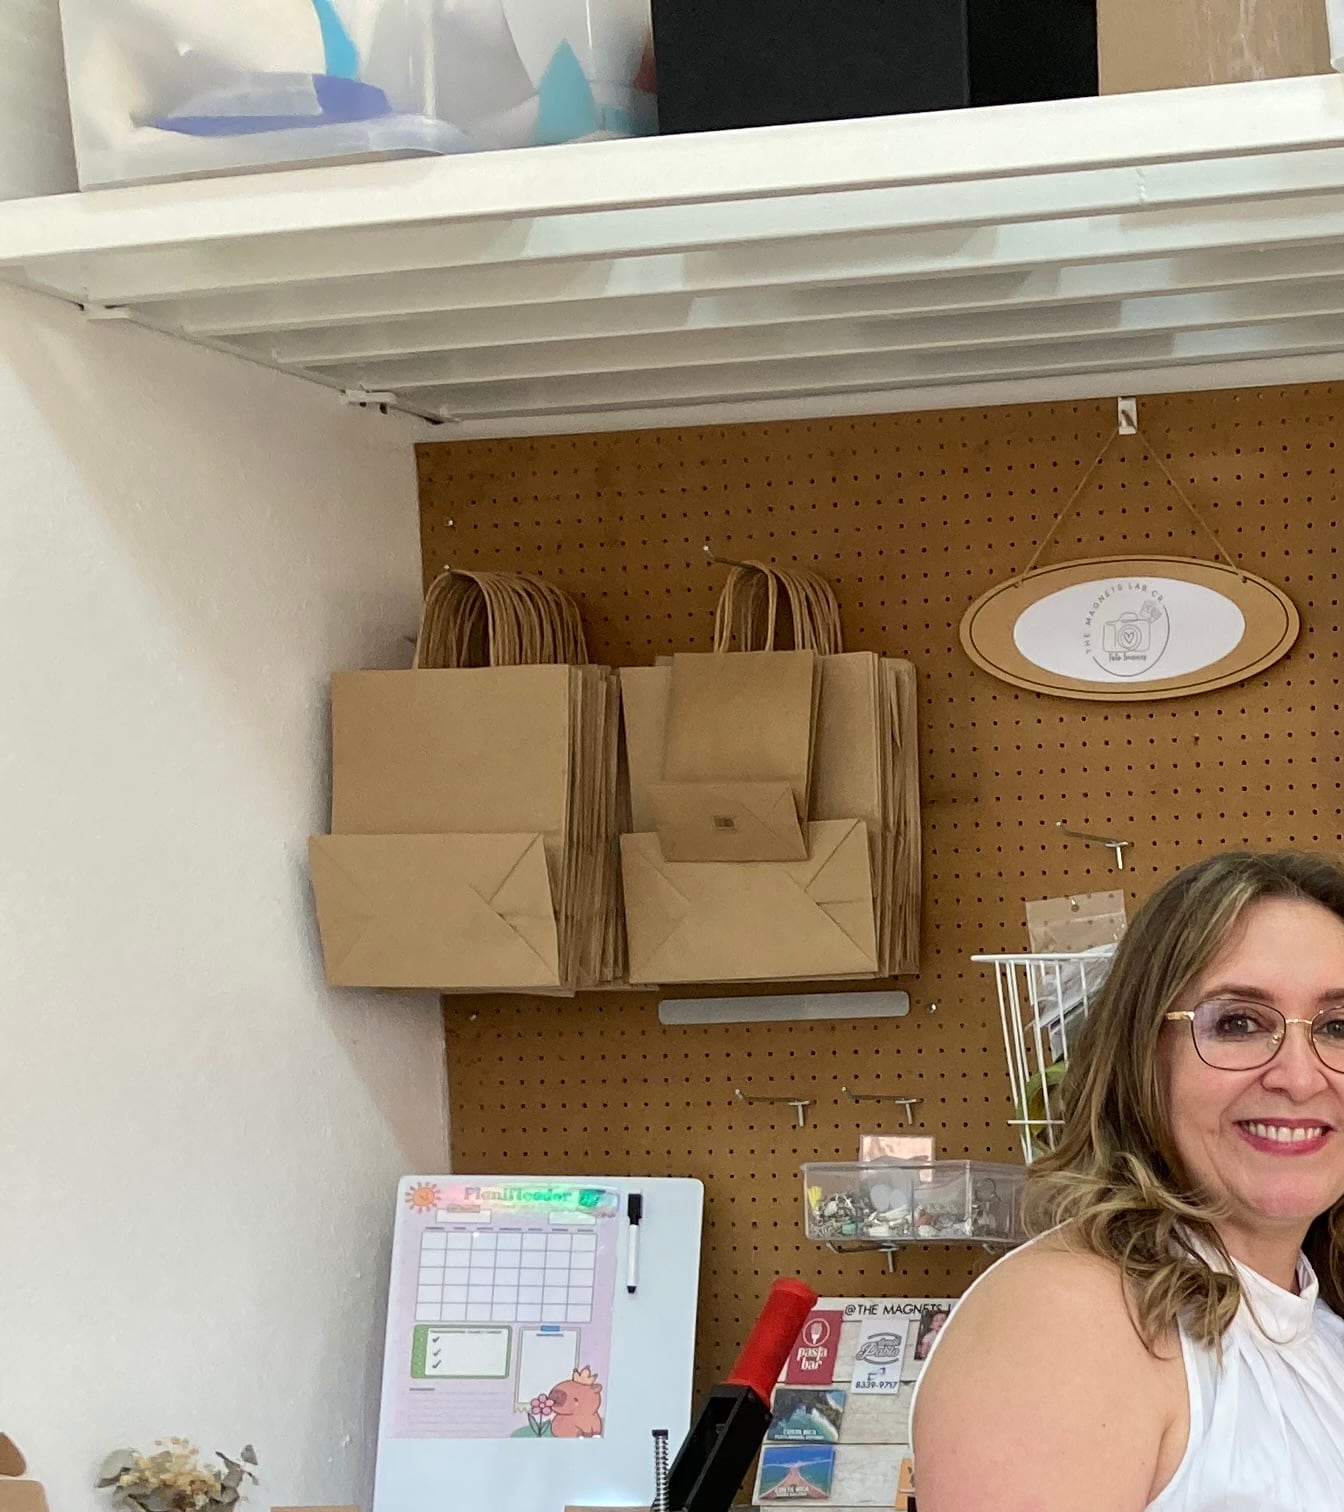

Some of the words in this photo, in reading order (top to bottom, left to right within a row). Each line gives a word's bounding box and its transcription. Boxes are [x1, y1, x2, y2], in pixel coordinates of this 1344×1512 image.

[1128, 583, 1148, 592] LAB
[1085, 584, 1123, 626] MAGNETS
[1083, 633, 1091, 654] THE
[797, 1346, 828, 1361] pasta
[801, 1357, 823, 1370] bar
